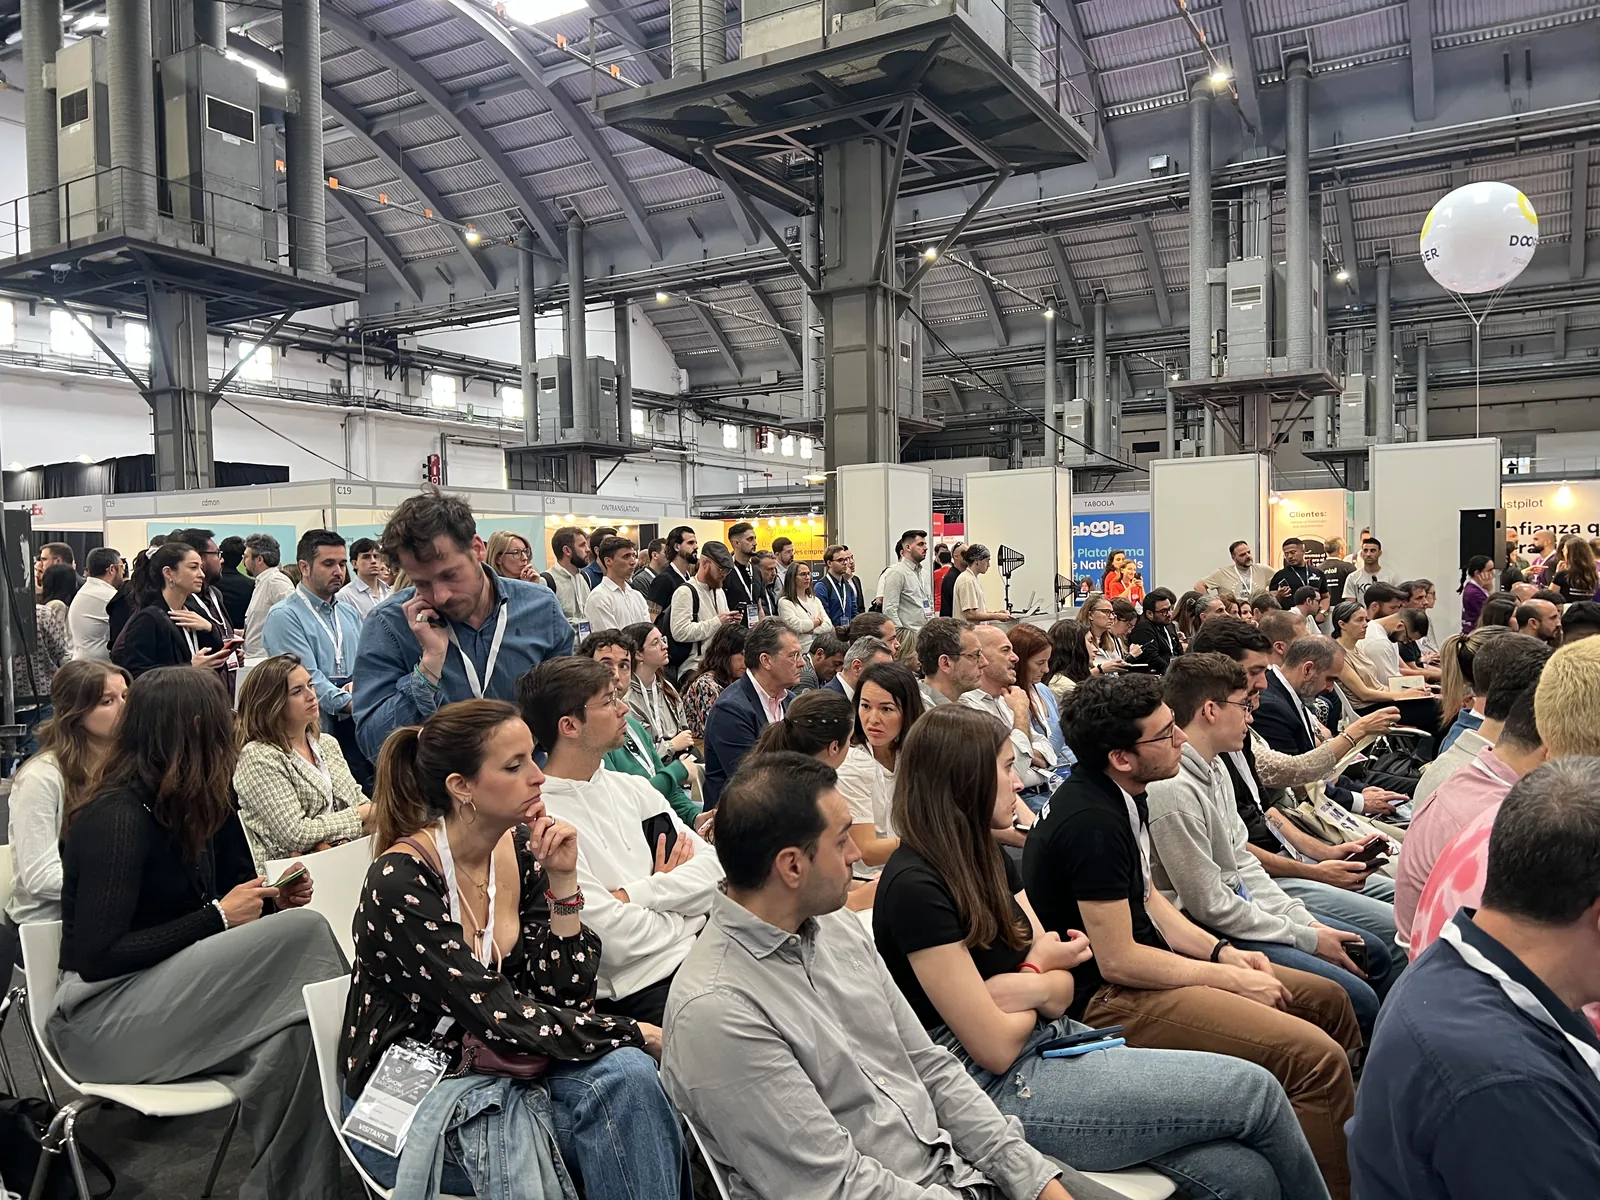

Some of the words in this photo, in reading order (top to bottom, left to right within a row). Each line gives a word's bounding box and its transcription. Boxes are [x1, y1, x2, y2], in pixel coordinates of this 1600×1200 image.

[1509, 235, 1536, 247] DOO
[337, 486, 352, 495] C19
[545, 497, 556, 505] C18
[1084, 500, 1115, 508] TABOOLA
[601, 504, 640, 513] ONTRANSLATION
[1077, 546, 1145, 558] Platafma
[358, 1122, 390, 1142] VISITANTE
